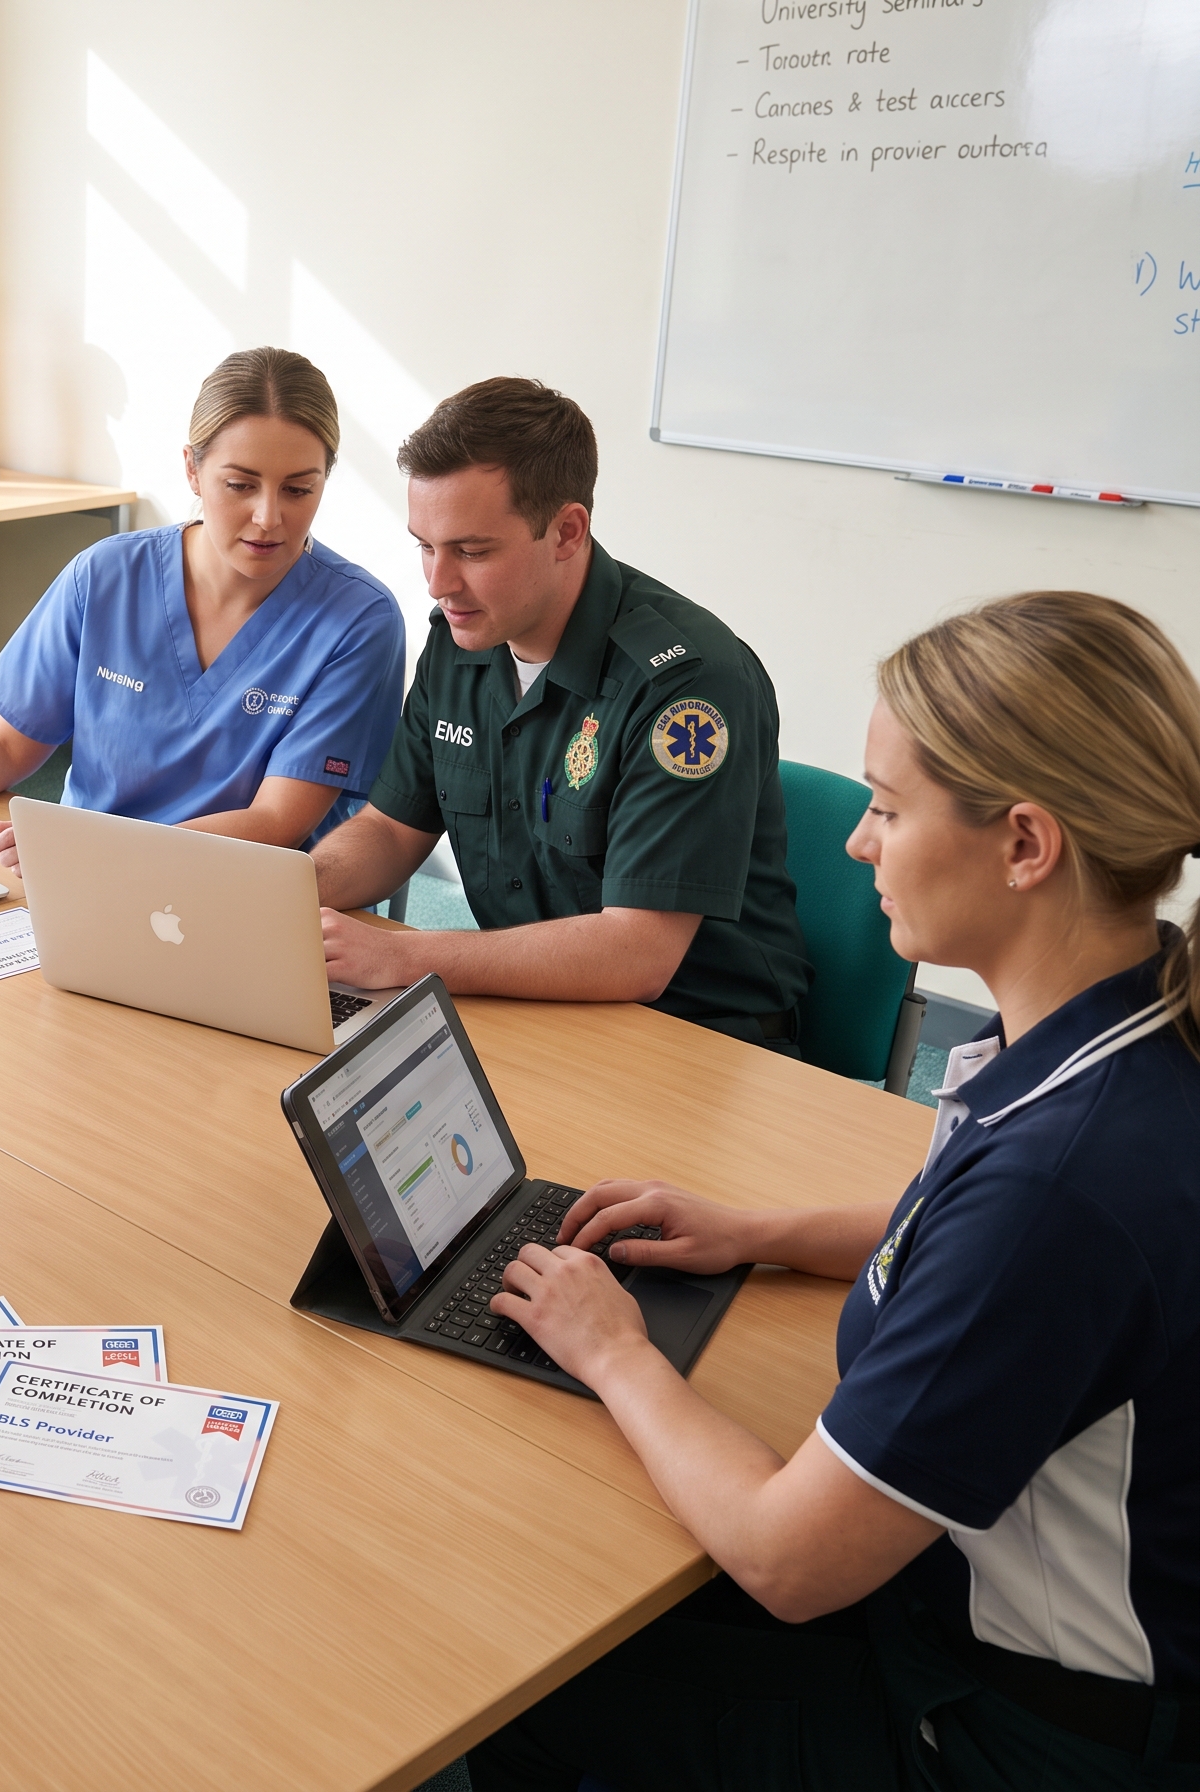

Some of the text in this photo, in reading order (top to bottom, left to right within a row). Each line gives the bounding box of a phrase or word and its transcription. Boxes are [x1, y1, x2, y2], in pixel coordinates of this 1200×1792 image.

[848, 92, 862, 112] &
[876, 88, 918, 112] test
[752, 137, 828, 174] Respite
[840, 142, 858, 162] in
[870, 139, 947, 172] provier
[649, 644, 687, 669] EMS
[434, 719, 474, 748] EMS
[32, 1339, 57, 1349] OF
[11, 1386, 135, 1416] COMPLETION
[16, 1374, 166, 1408] CERTIFICATE OF
[35, 1421, 115, 1443] Provider
